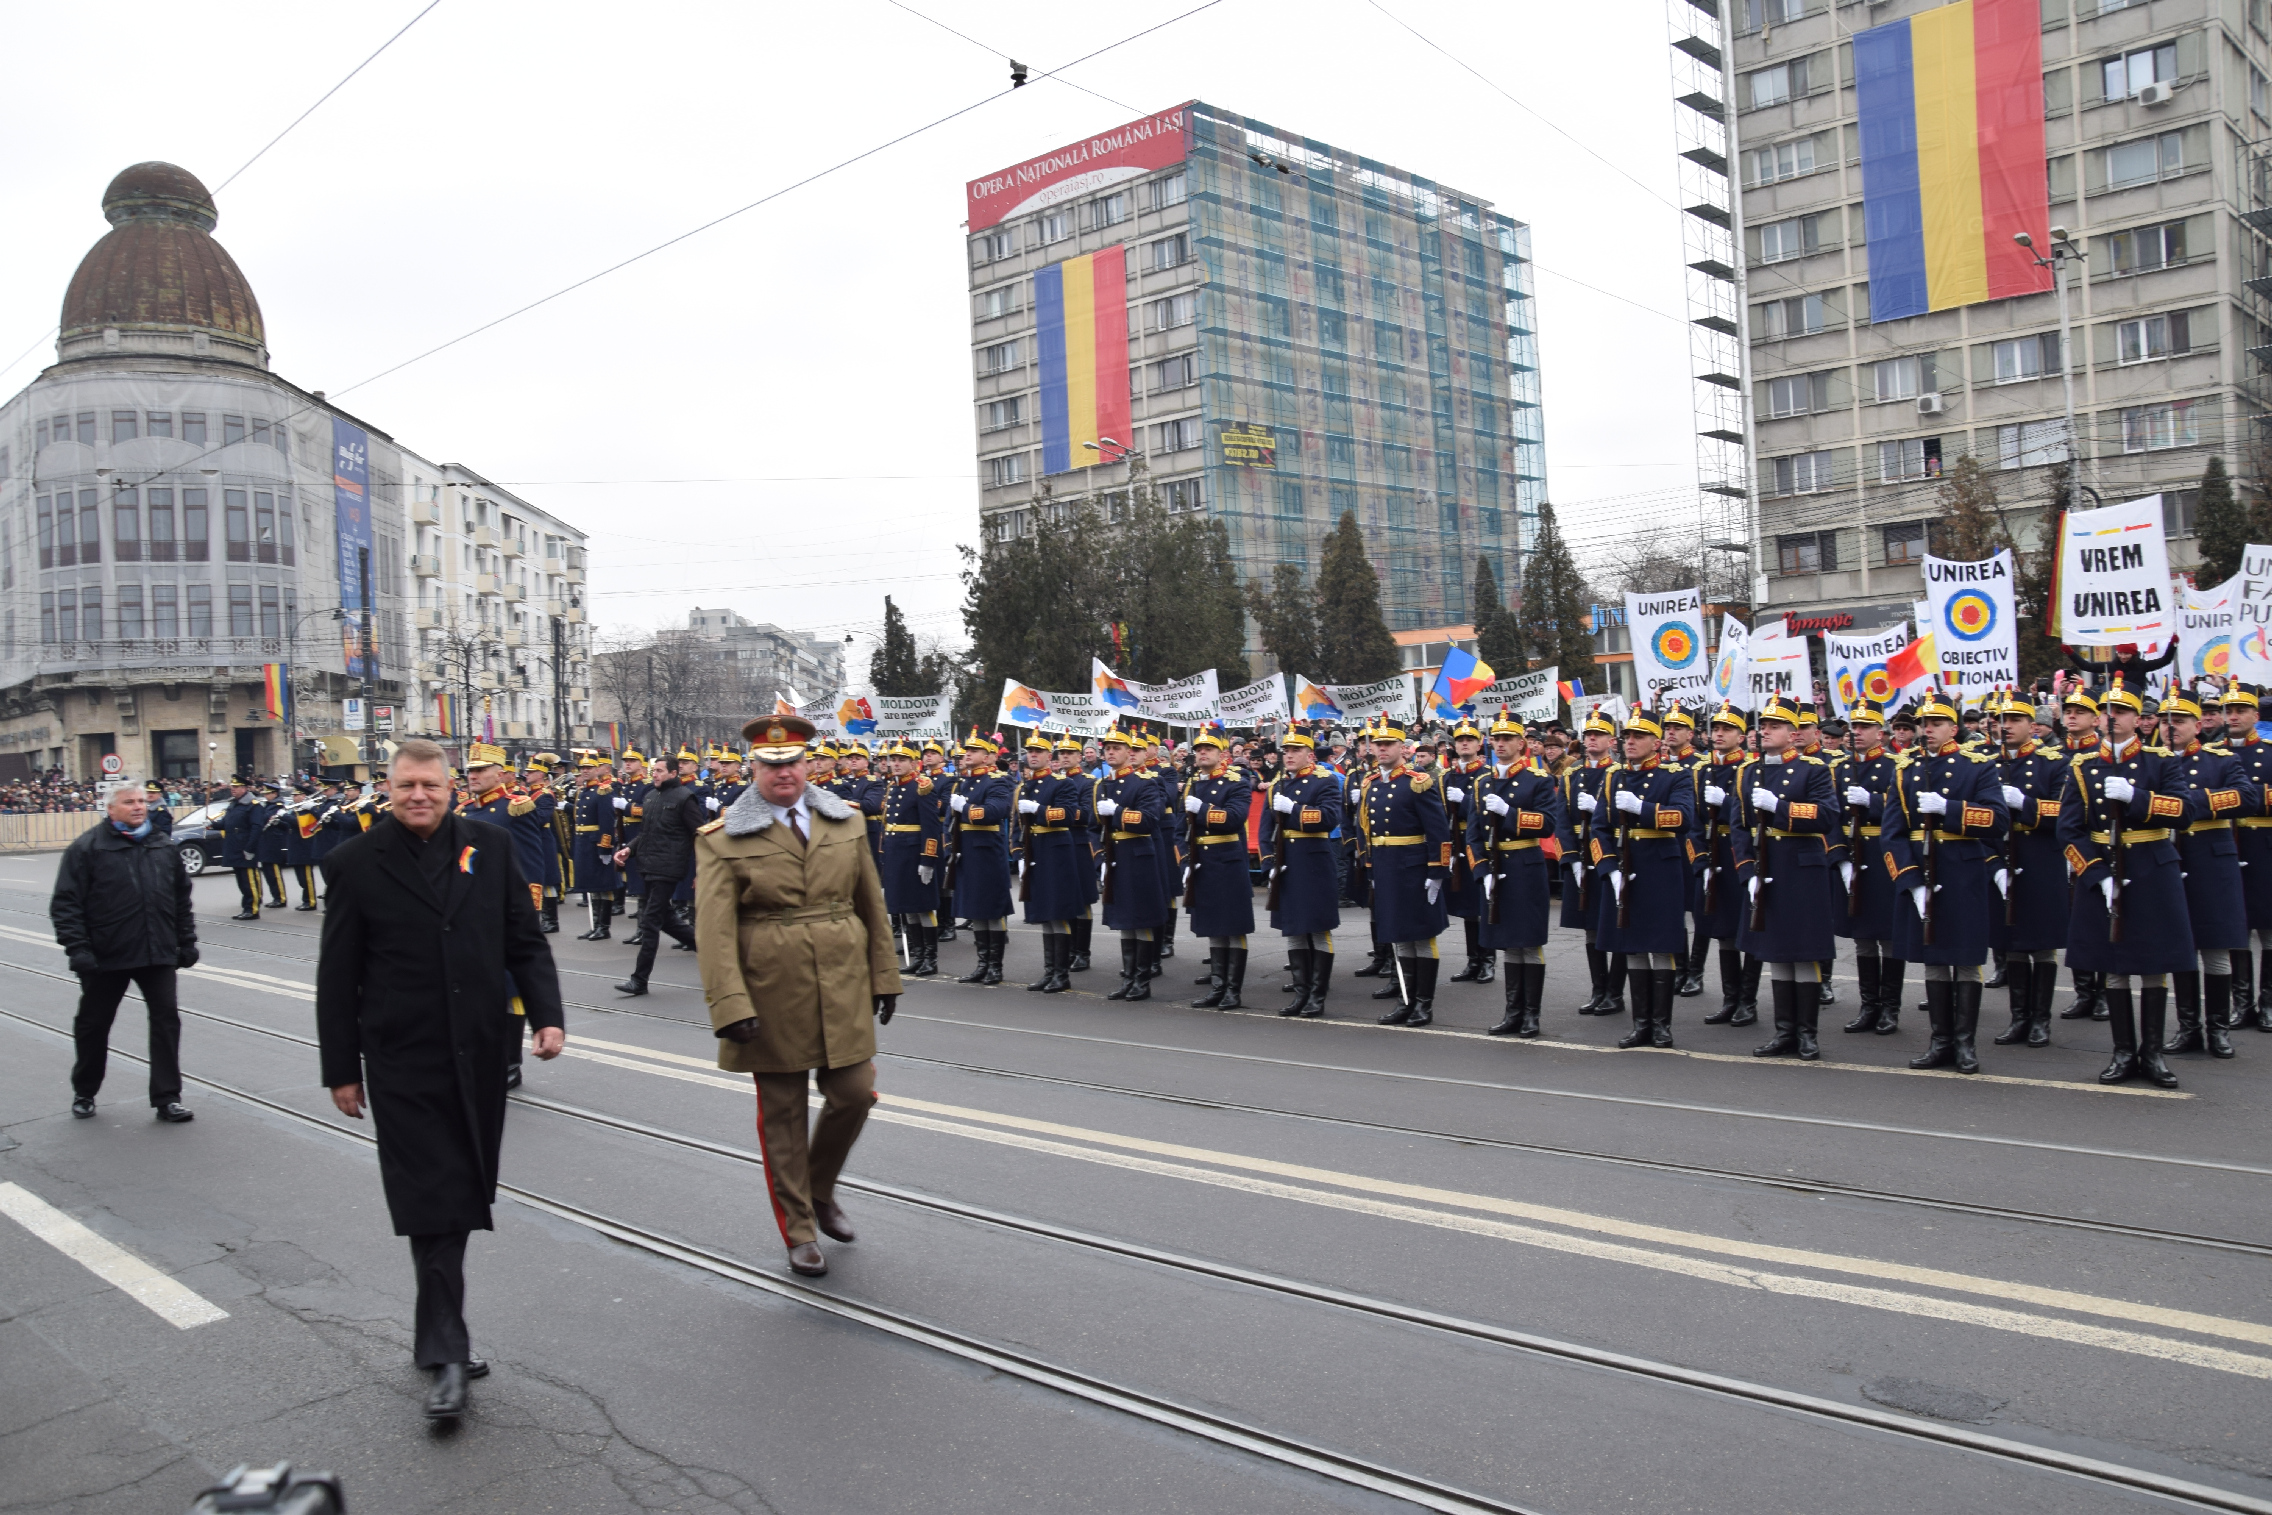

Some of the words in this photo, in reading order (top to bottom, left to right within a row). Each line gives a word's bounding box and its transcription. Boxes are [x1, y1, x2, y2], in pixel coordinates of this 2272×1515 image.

[973, 174, 1014, 199] OPERA
[1092, 120, 1153, 158] ROMÂNĂ
[2080, 543, 2143, 572] VREM
[1929, 561, 2006, 582] UNIREA
[1639, 596, 1699, 616] UNIREA
[2074, 588, 2162, 617] UNIREA
[1942, 647, 2008, 665] OBIECTIV
[1338, 678, 1405, 701] MOLDOVA
[1749, 669, 1792, 693] REM
[880, 698, 939, 709] MOLDOVA
[1163, 688, 1202, 701] nevoie
[1238, 692, 1273, 710] nevoie
[1347, 702, 1366, 710] are
[1365, 692, 1403, 706] nevoie
[1482, 695, 1502, 704] are
[1504, 687, 1544, 703] nevoie
[884, 712, 900, 720] are
[901, 709, 937, 719] nevoie
[1056, 707, 1072, 715] are
[106, 758, 118, 769] 10
